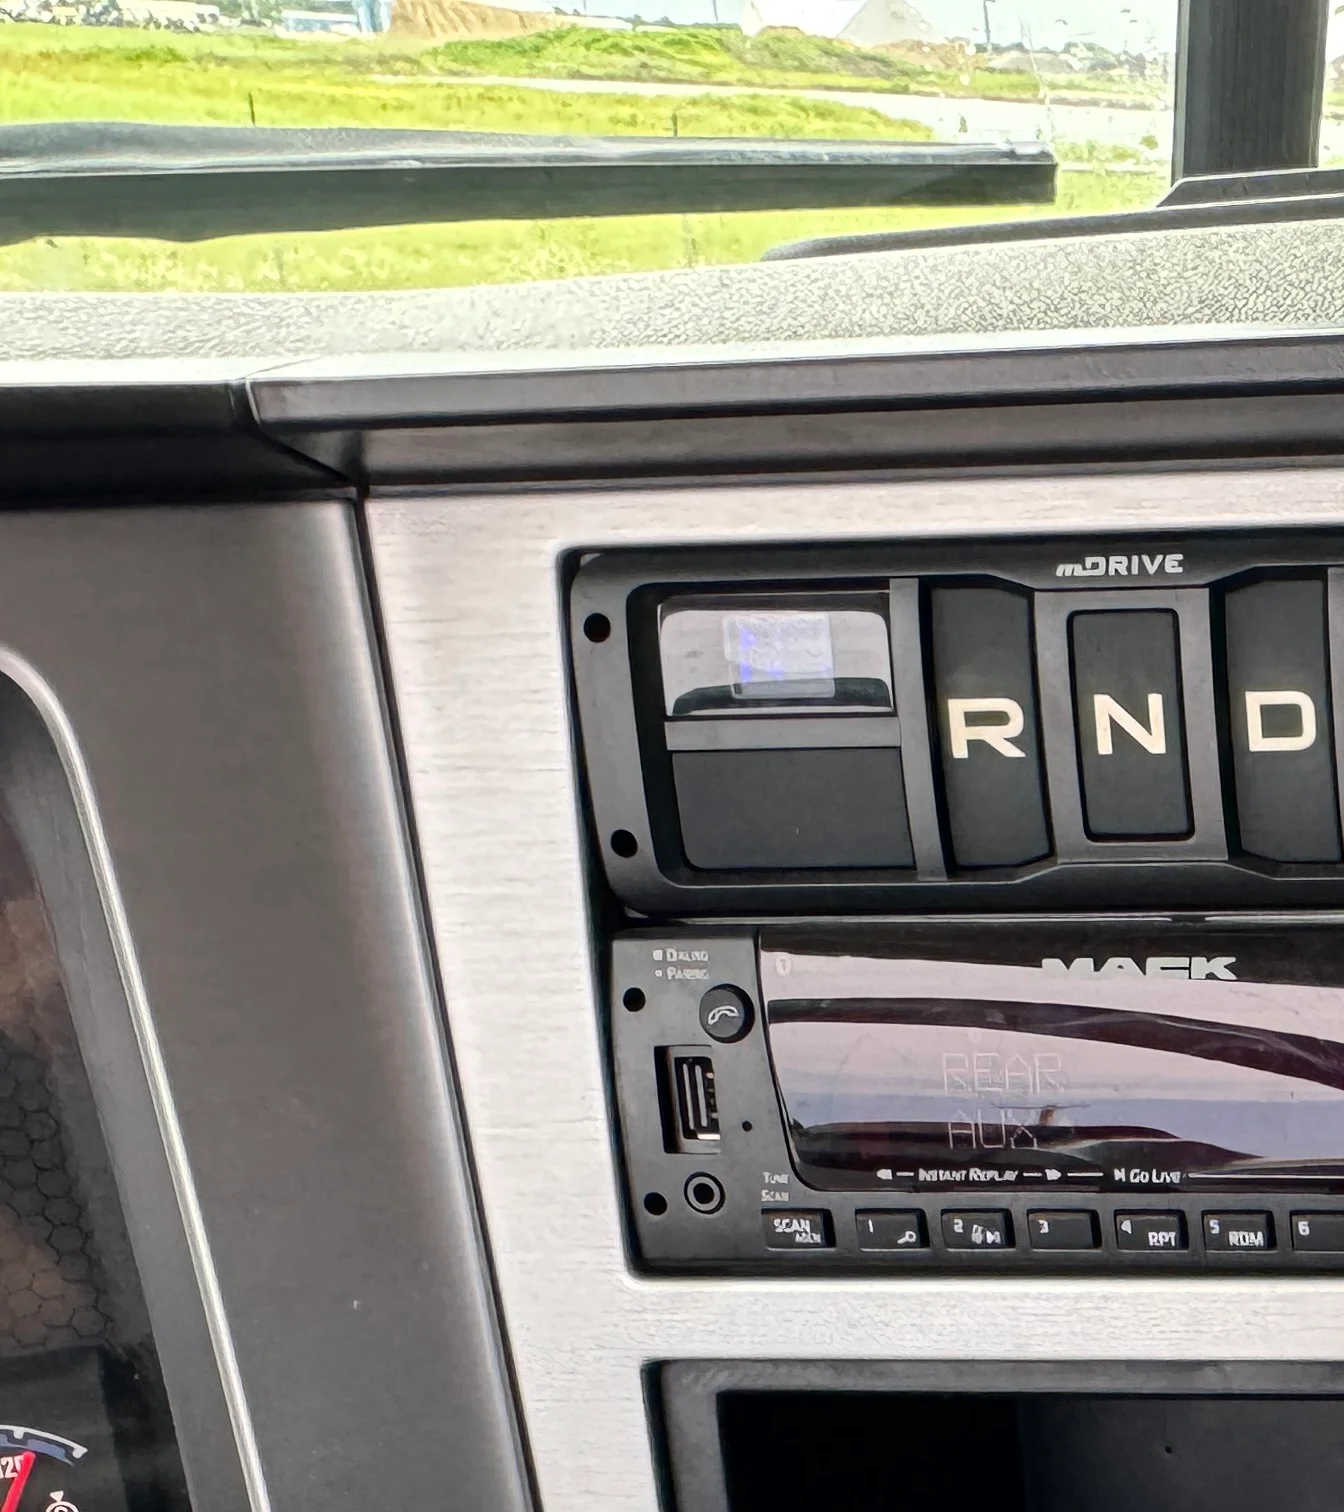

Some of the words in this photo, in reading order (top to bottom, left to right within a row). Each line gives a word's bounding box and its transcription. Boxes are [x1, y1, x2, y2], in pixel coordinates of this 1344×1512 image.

[947, 698, 1027, 759] R
[1093, 693, 1166, 756] N
[1245, 690, 1317, 752] D
[1041, 956, 1237, 981] MACK
[943, 1052, 1065, 1096] REAR
[953, 1219, 964, 1233] 2
[1039, 1219, 1049, 1234] 3
[1209, 1219, 1220, 1235] 5
